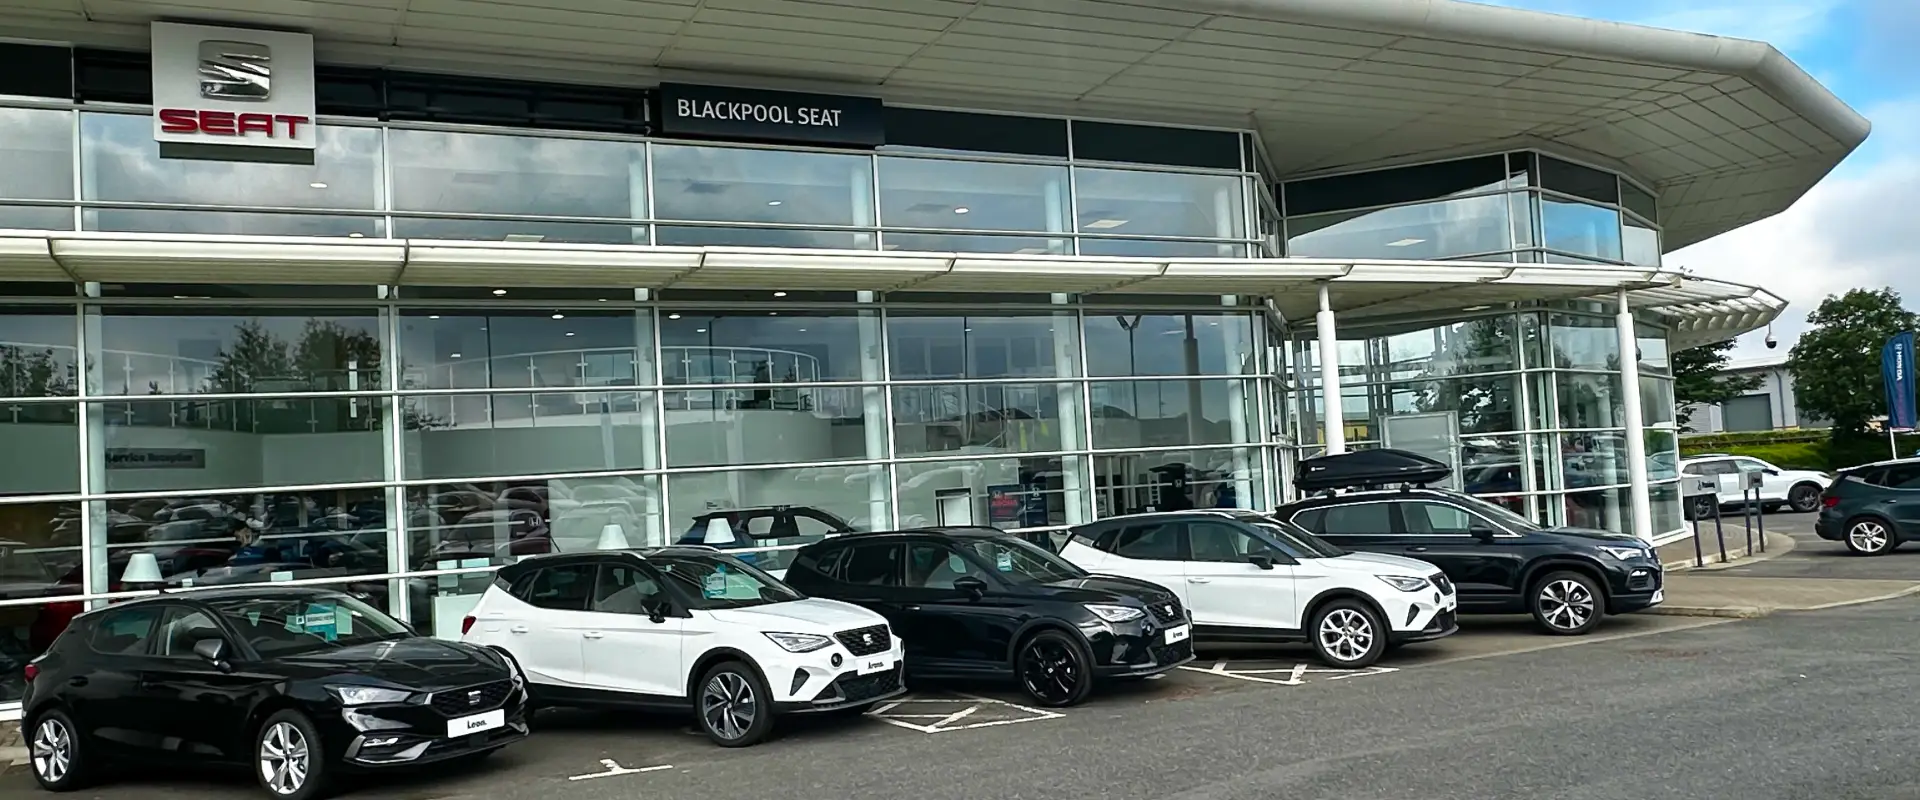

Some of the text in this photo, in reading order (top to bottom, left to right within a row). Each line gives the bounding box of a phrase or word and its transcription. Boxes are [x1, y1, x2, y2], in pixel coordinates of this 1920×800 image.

[159, 109, 309, 138] SEAT
[677, 98, 841, 127] BLACKPOOL SEAT
[1896, 351, 1904, 381] HONDA
